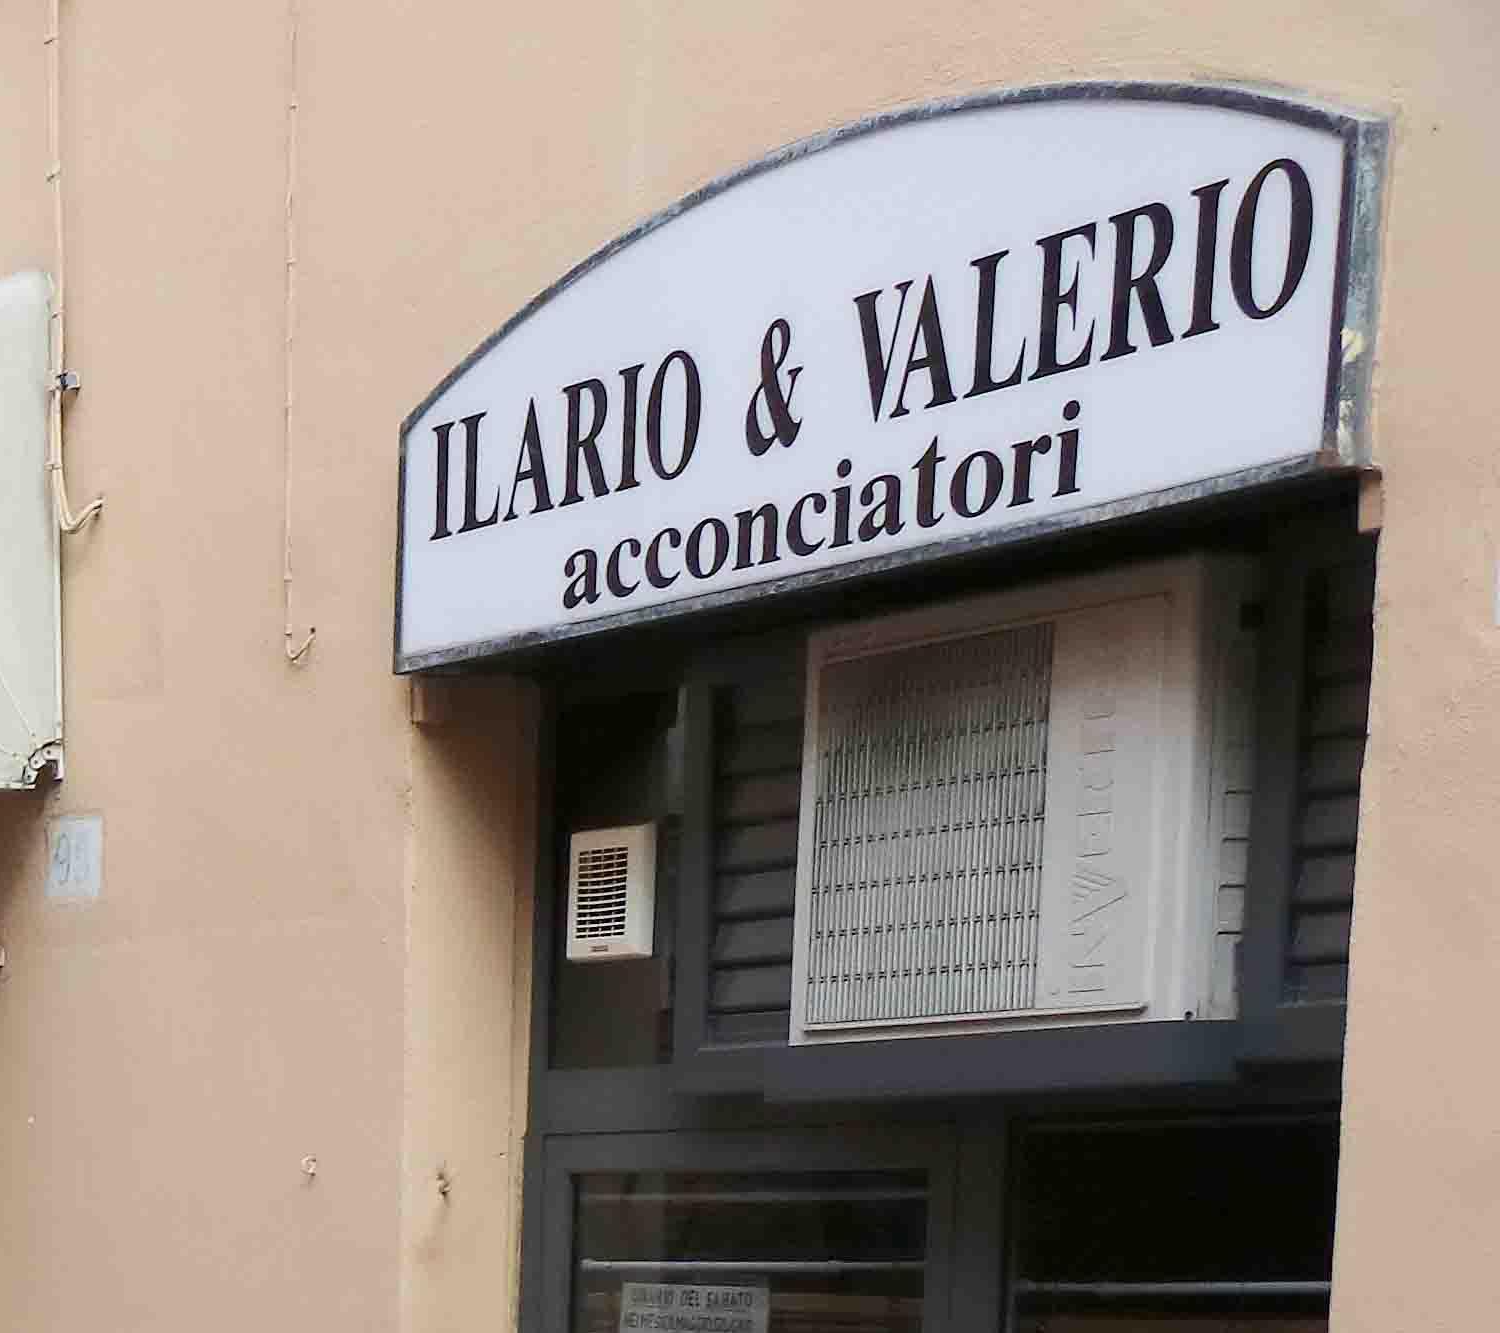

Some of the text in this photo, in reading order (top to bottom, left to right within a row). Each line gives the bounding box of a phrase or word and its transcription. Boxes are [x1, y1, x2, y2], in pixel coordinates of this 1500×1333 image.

[429, 157, 1314, 542] ILARIO & VALERIO
[562, 400, 1082, 610] acconciatori
